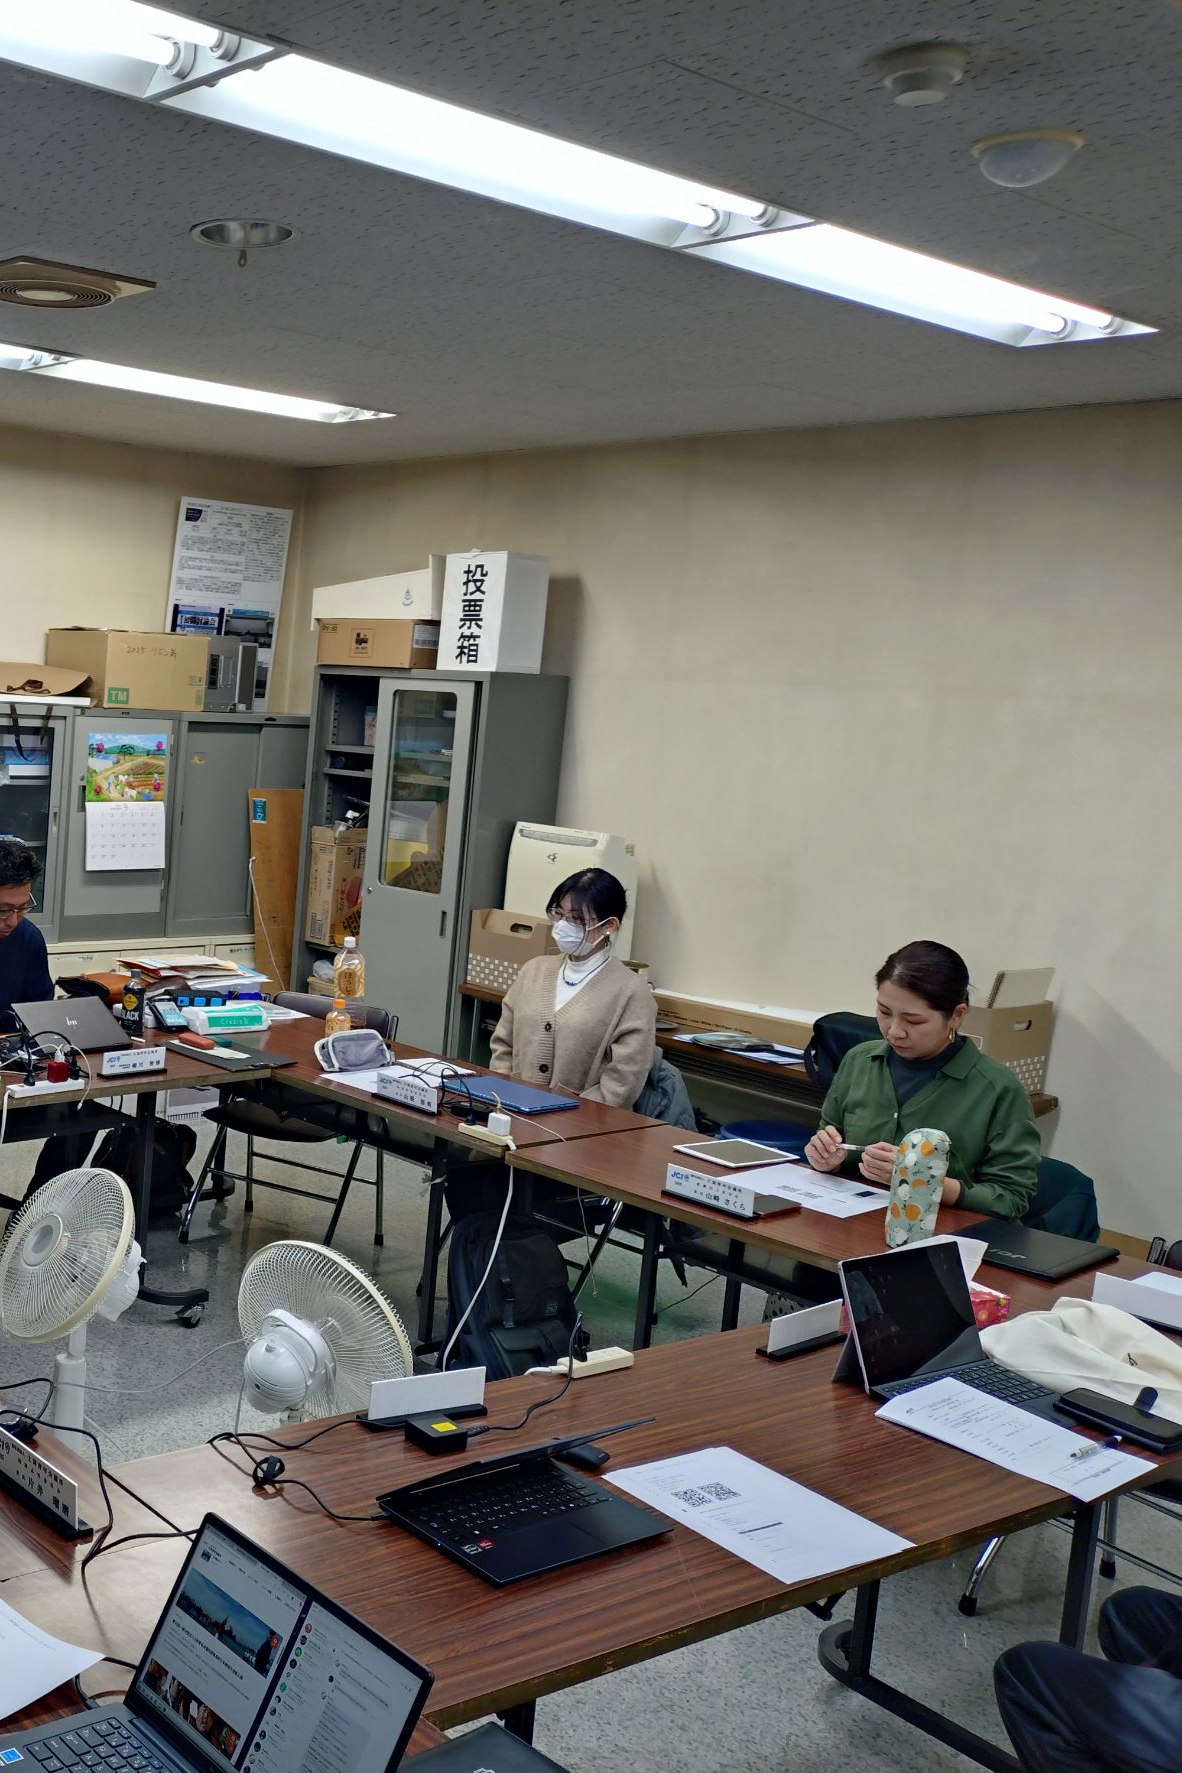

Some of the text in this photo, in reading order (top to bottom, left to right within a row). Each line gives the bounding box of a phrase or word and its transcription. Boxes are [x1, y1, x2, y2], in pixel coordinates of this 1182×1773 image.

[455, 563, 489, 665] 投票箱
[724, 1198, 746, 1211] さくら
